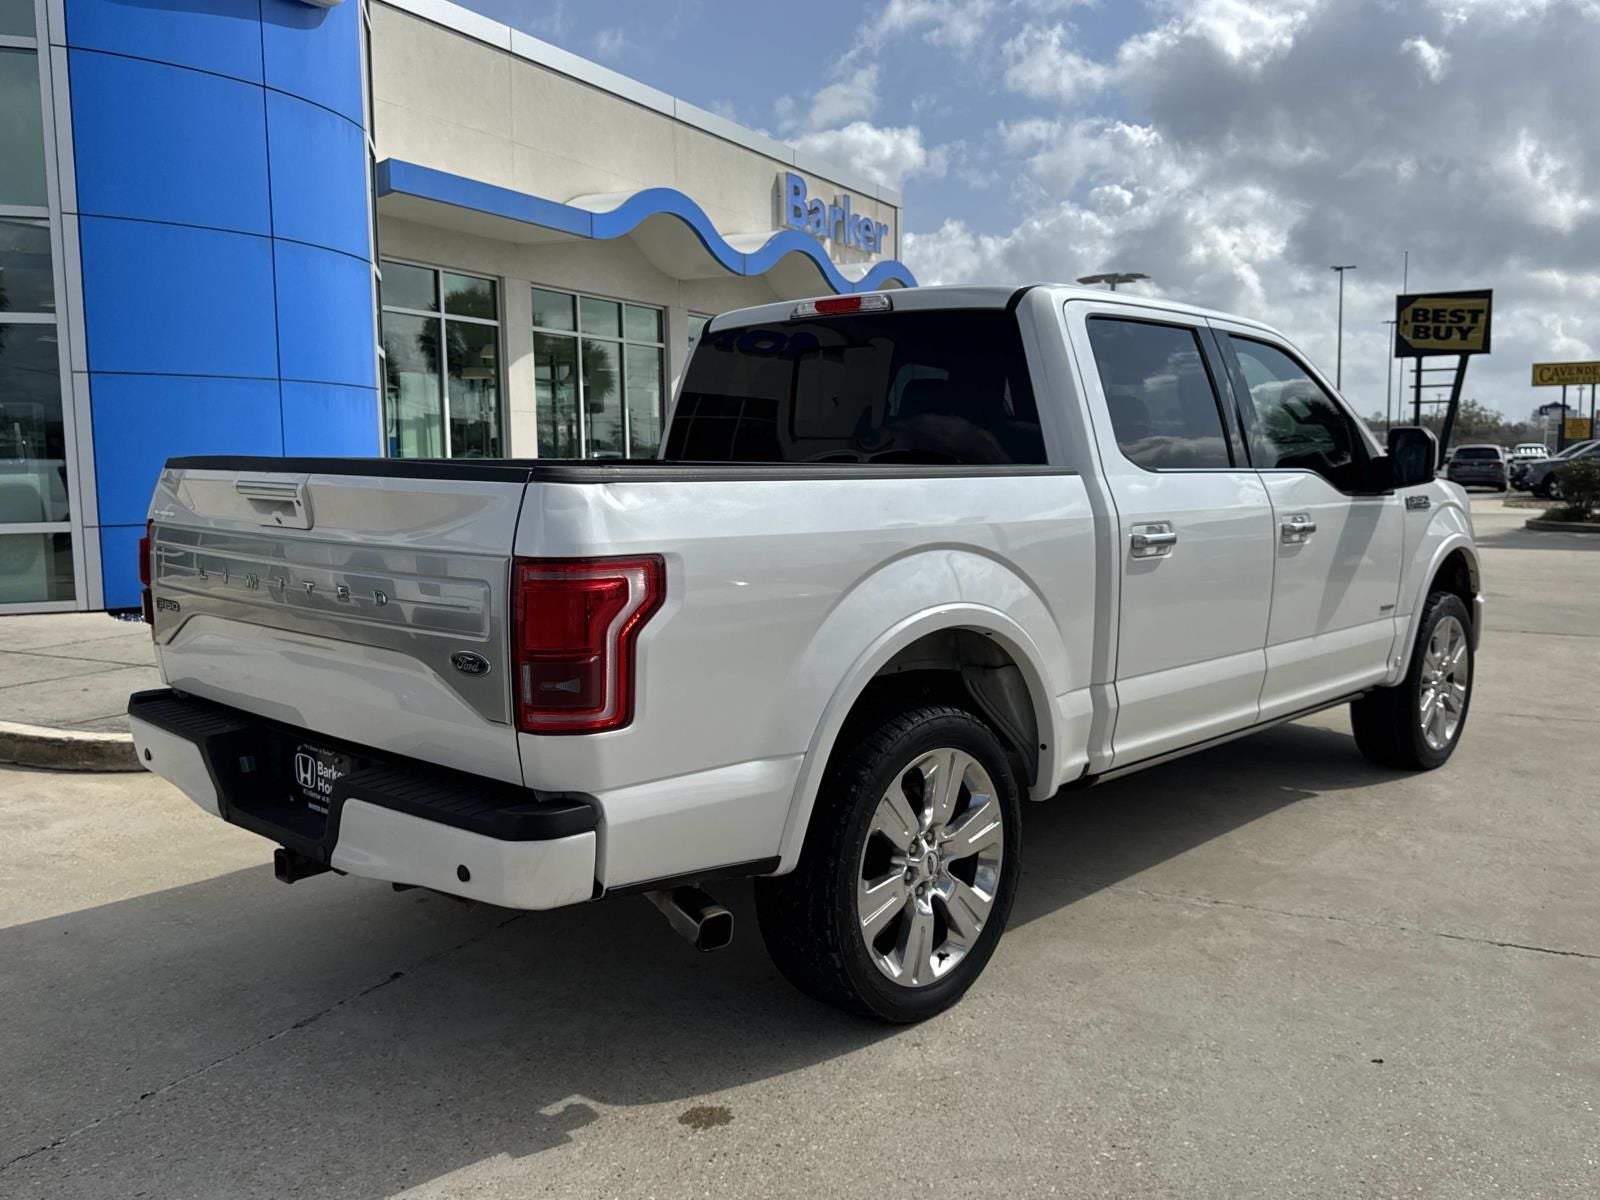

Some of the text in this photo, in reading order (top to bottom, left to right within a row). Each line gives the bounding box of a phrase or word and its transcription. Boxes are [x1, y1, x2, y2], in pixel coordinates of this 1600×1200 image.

[785, 171, 889, 254] Barker
[1411, 308, 1485, 324] BEST
[1411, 325, 1476, 341] BUY
[198, 567, 389, 607] LIMITED
[317, 760, 346, 780] Barke
